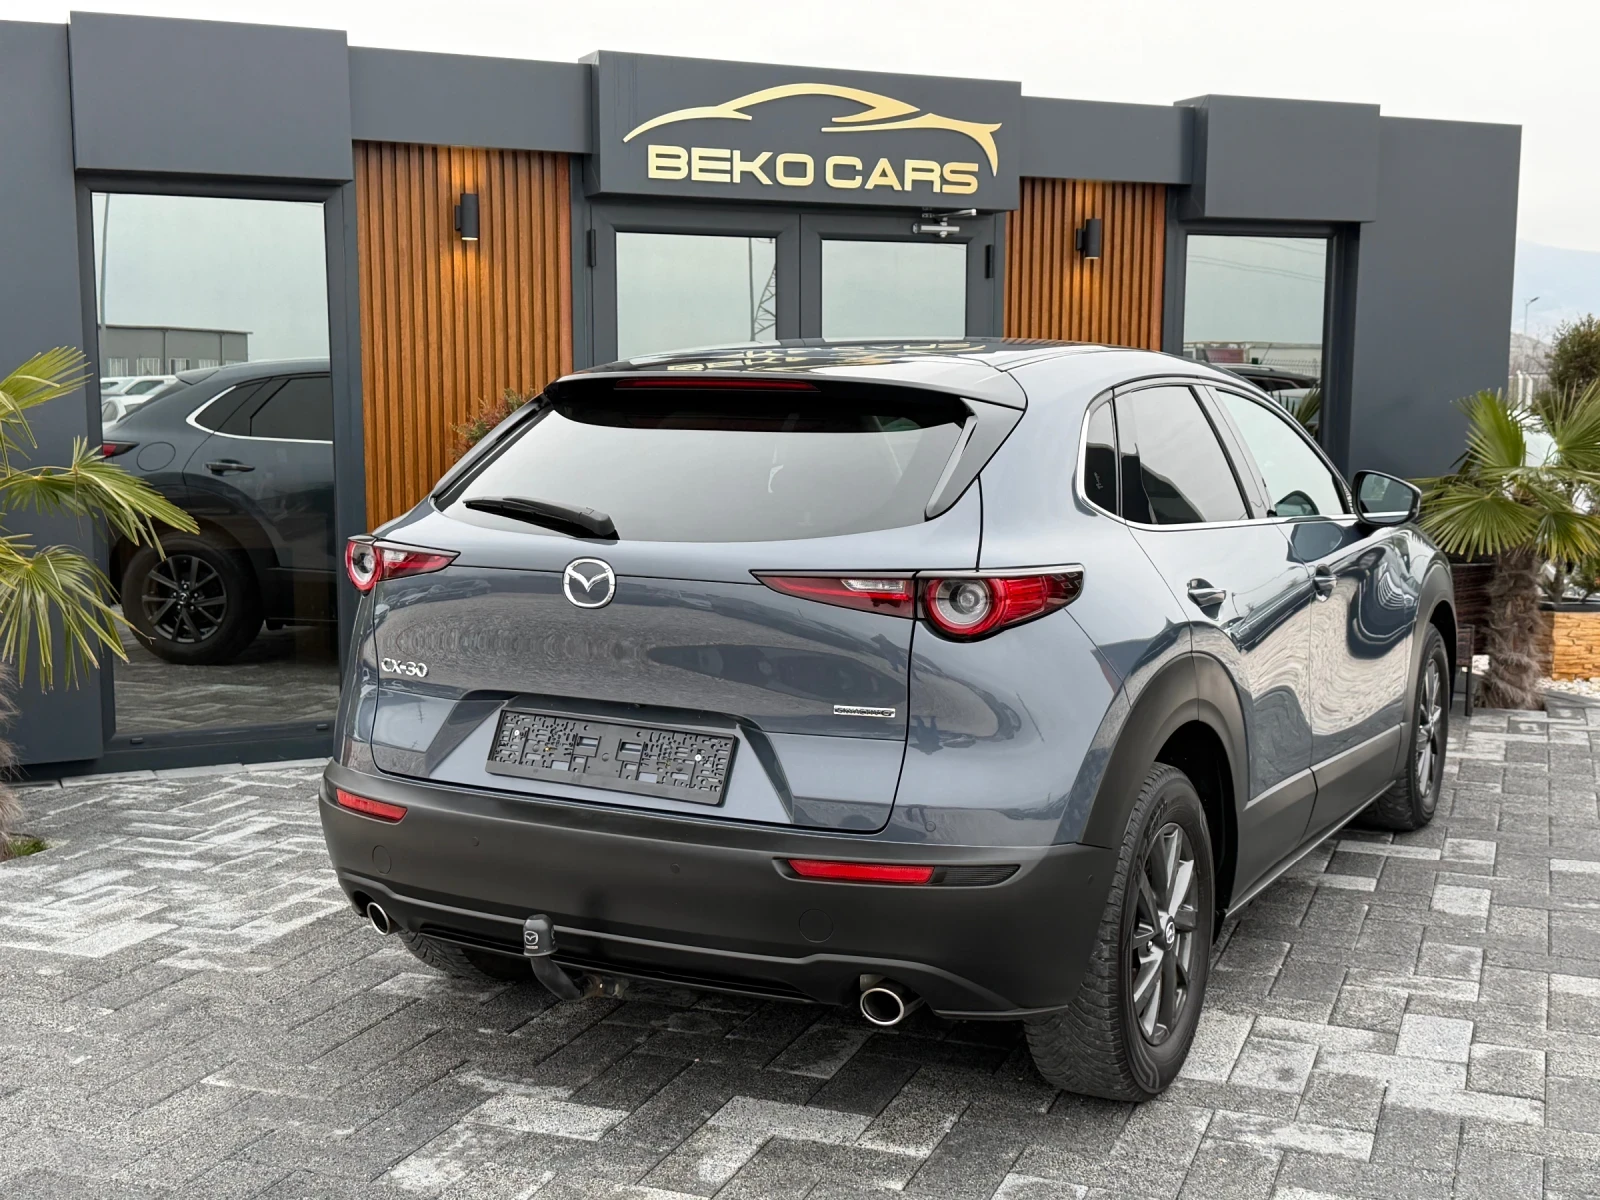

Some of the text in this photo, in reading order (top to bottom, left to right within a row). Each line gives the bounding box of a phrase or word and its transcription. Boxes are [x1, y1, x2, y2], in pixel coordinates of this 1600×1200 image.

[648, 145, 979, 194] BEKO CARS
[381, 657, 428, 678] CX-30
